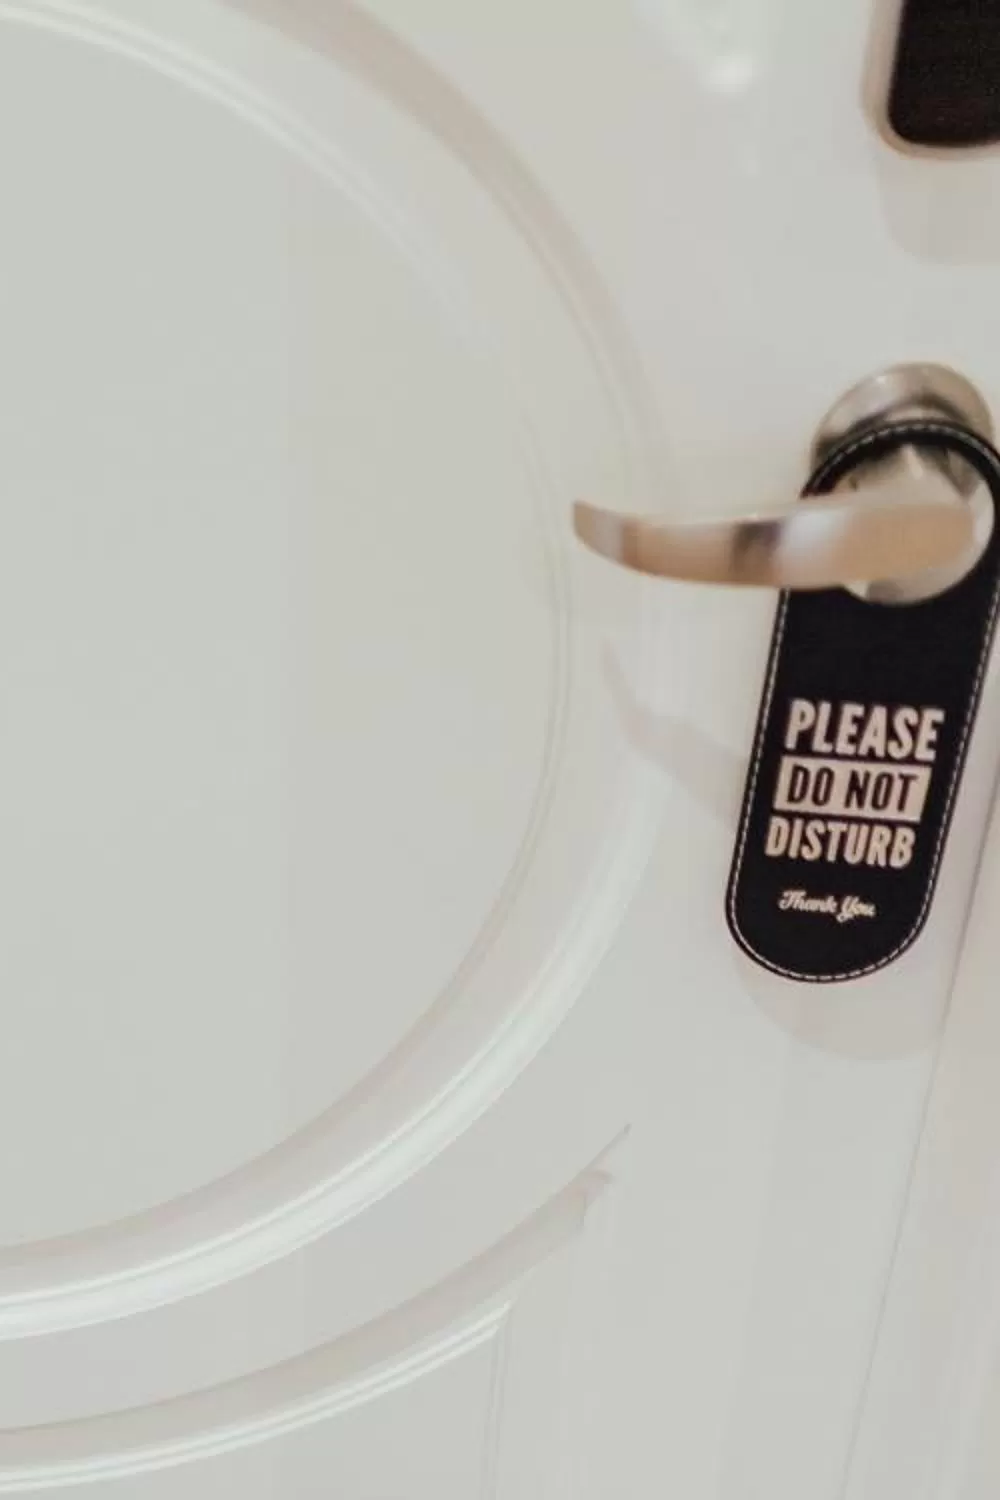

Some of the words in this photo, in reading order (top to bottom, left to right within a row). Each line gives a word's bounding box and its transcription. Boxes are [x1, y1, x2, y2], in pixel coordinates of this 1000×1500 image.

[784, 698, 945, 762] PLEASE
[786, 764, 835, 807] DO
[844, 769, 920, 812] NOT
[765, 816, 916, 869] DISTURB
[778, 889, 838, 912] Thank
[836, 894, 876, 923] You
